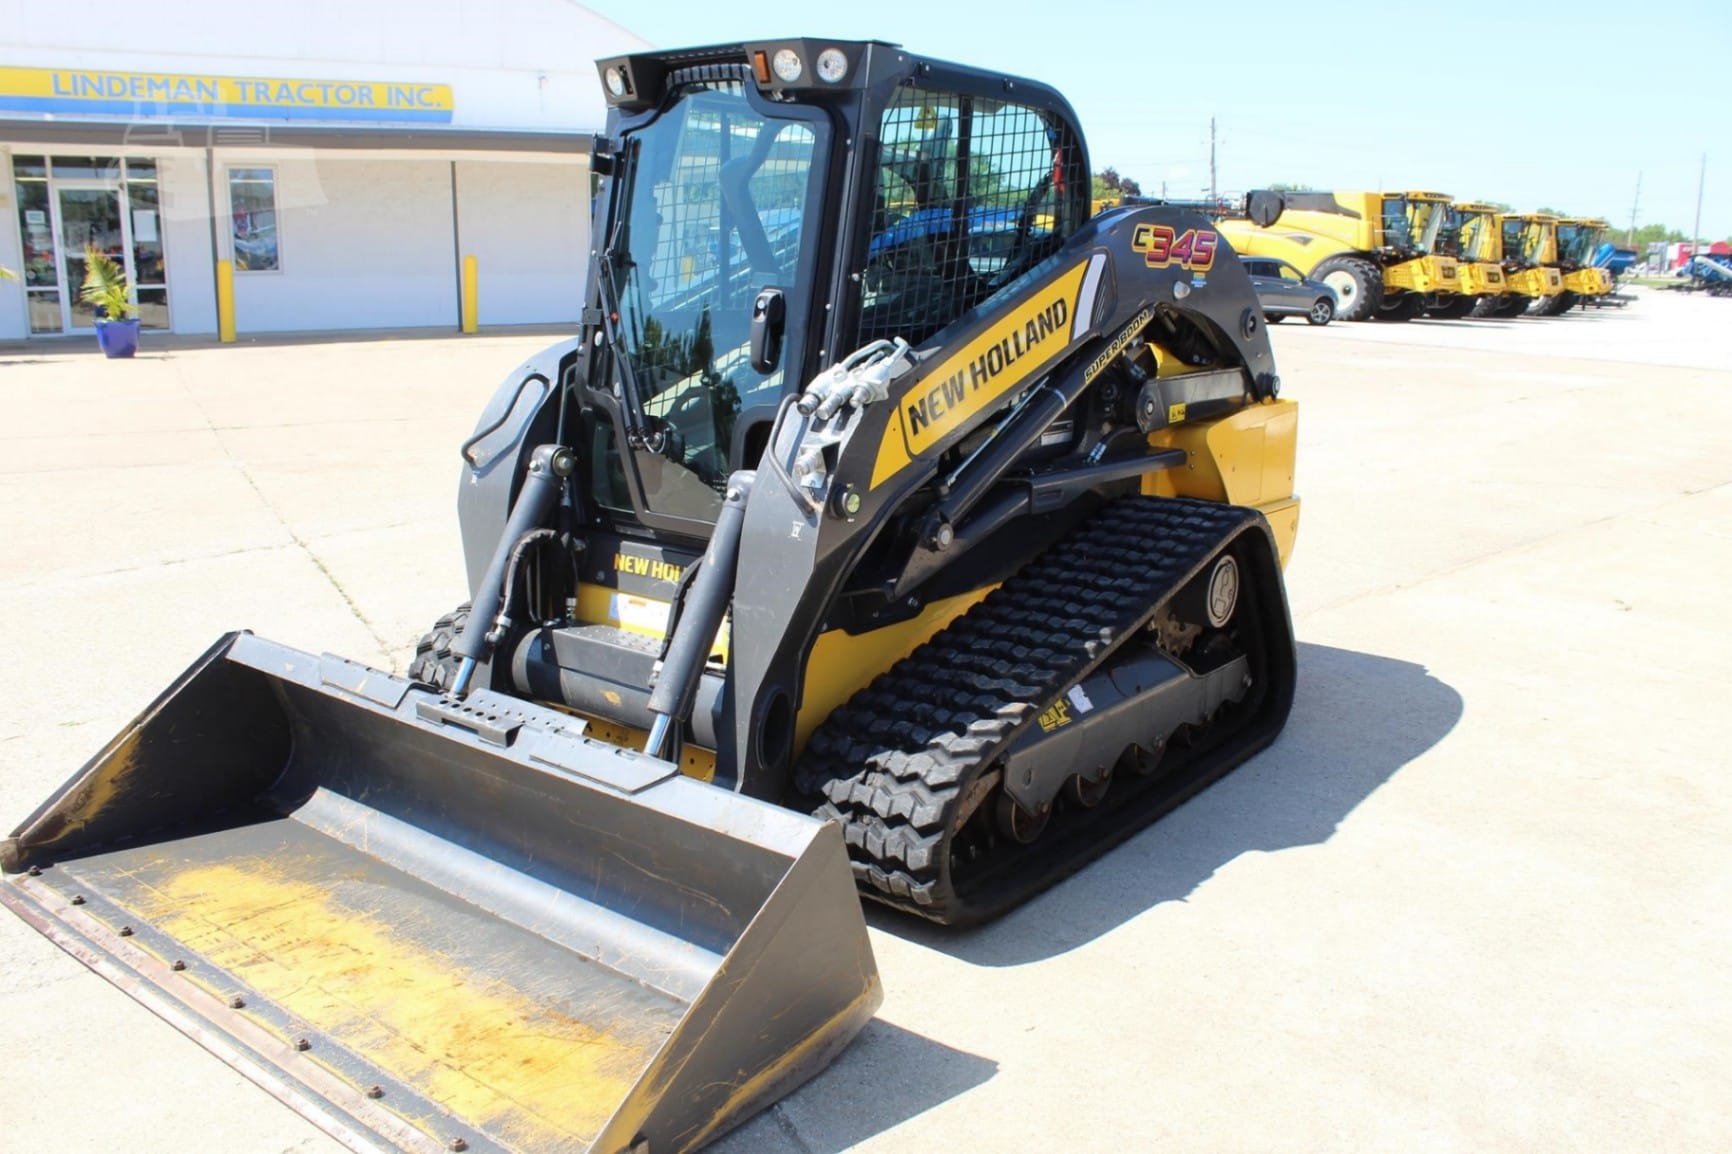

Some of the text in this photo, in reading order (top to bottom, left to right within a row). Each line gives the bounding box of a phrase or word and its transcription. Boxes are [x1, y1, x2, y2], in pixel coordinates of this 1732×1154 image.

[51, 73, 442, 107] LINDEMAN TRACTOR INC.
[1132, 225, 1217, 269] C345
[907, 297, 1068, 436] NEW HOLLAND
[1084, 338, 1120, 382] SUPER
[614, 553, 650, 576] NEW
